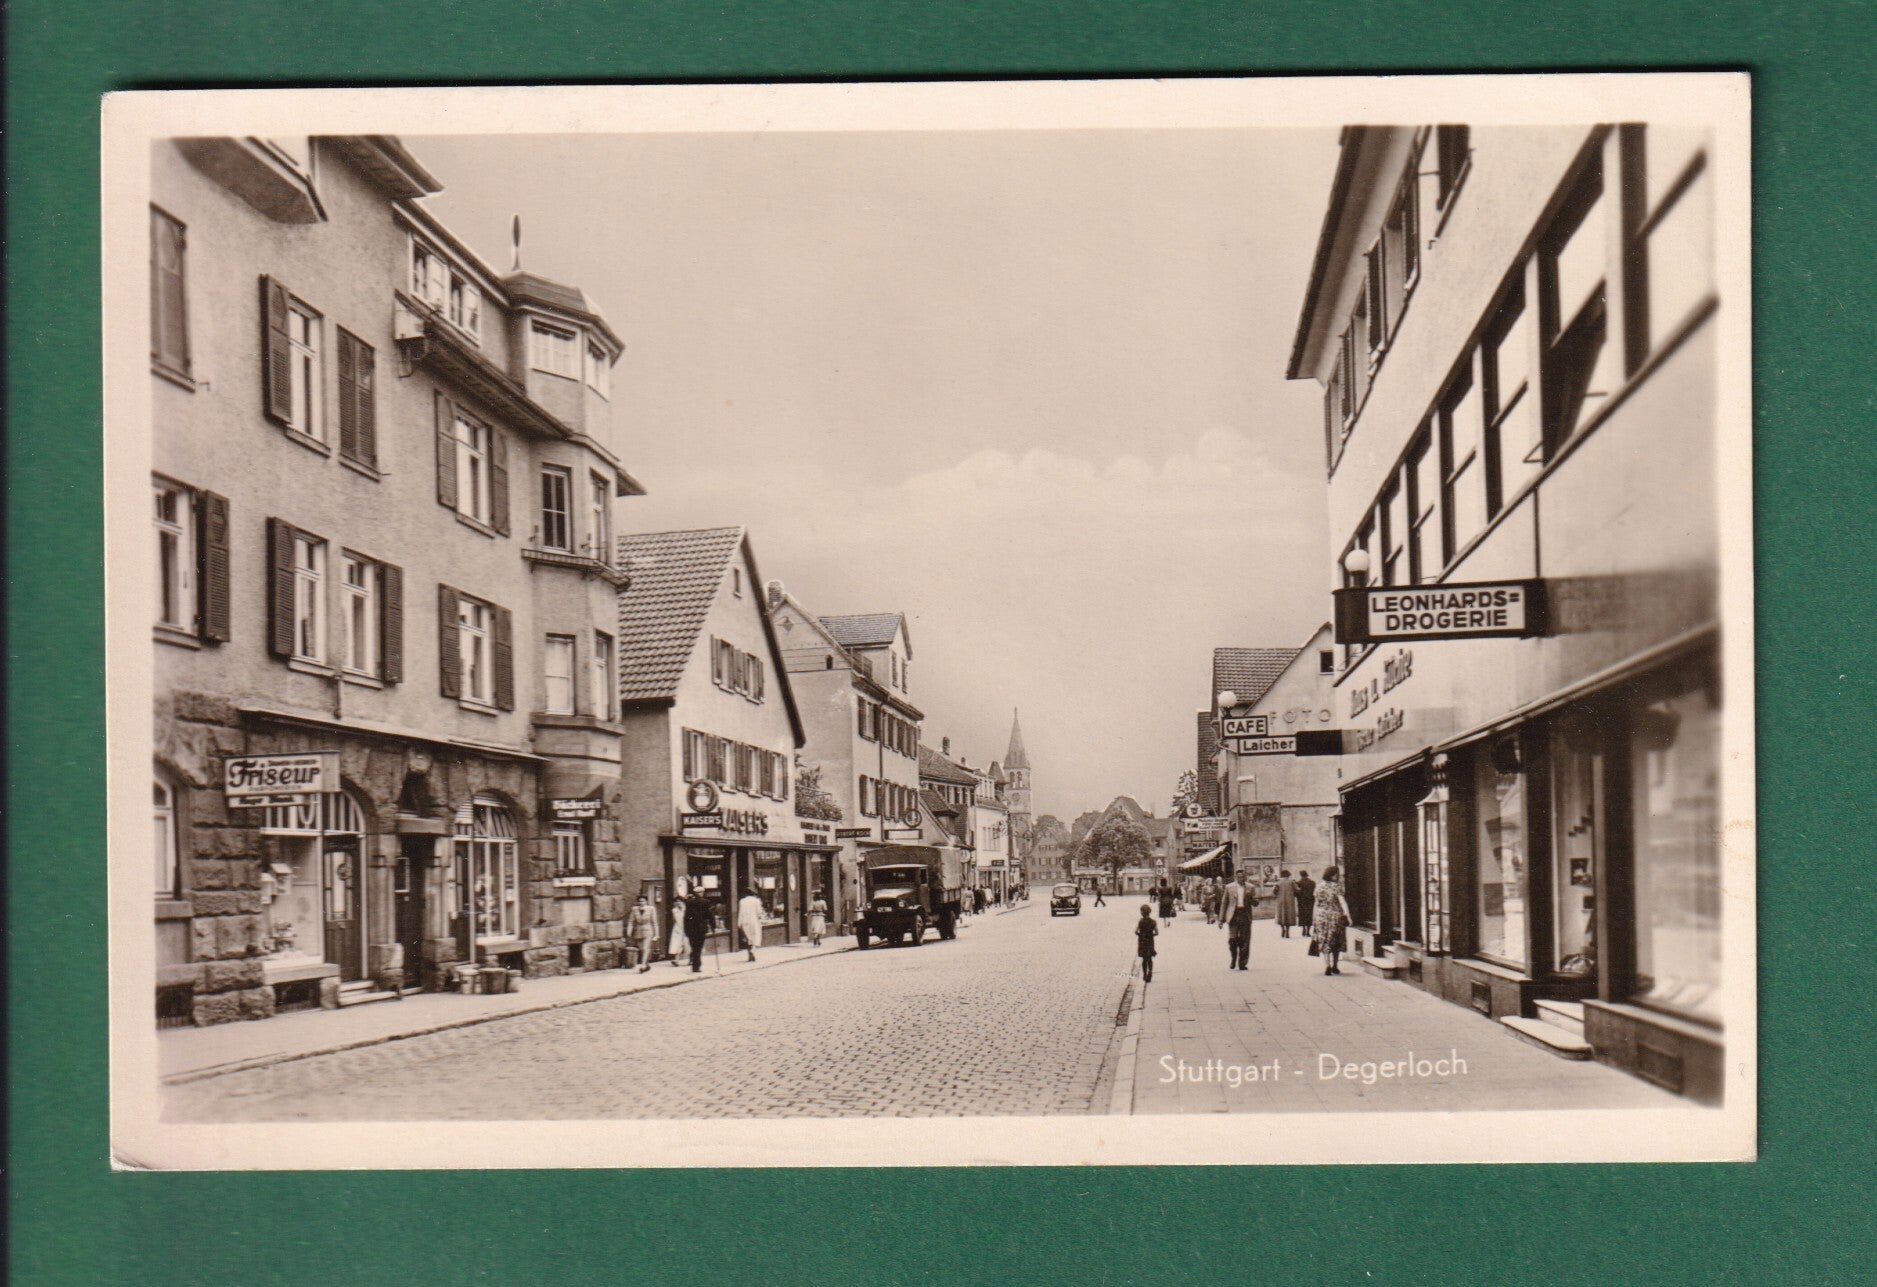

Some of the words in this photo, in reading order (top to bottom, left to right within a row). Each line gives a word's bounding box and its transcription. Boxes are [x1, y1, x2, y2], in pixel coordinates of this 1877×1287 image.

[1386, 608, 1508, 632] DROGERIE
[1243, 739, 1295, 752] Laicher
[229, 760, 320, 788] Friseur
[683, 815, 721, 825] KAISER'S
